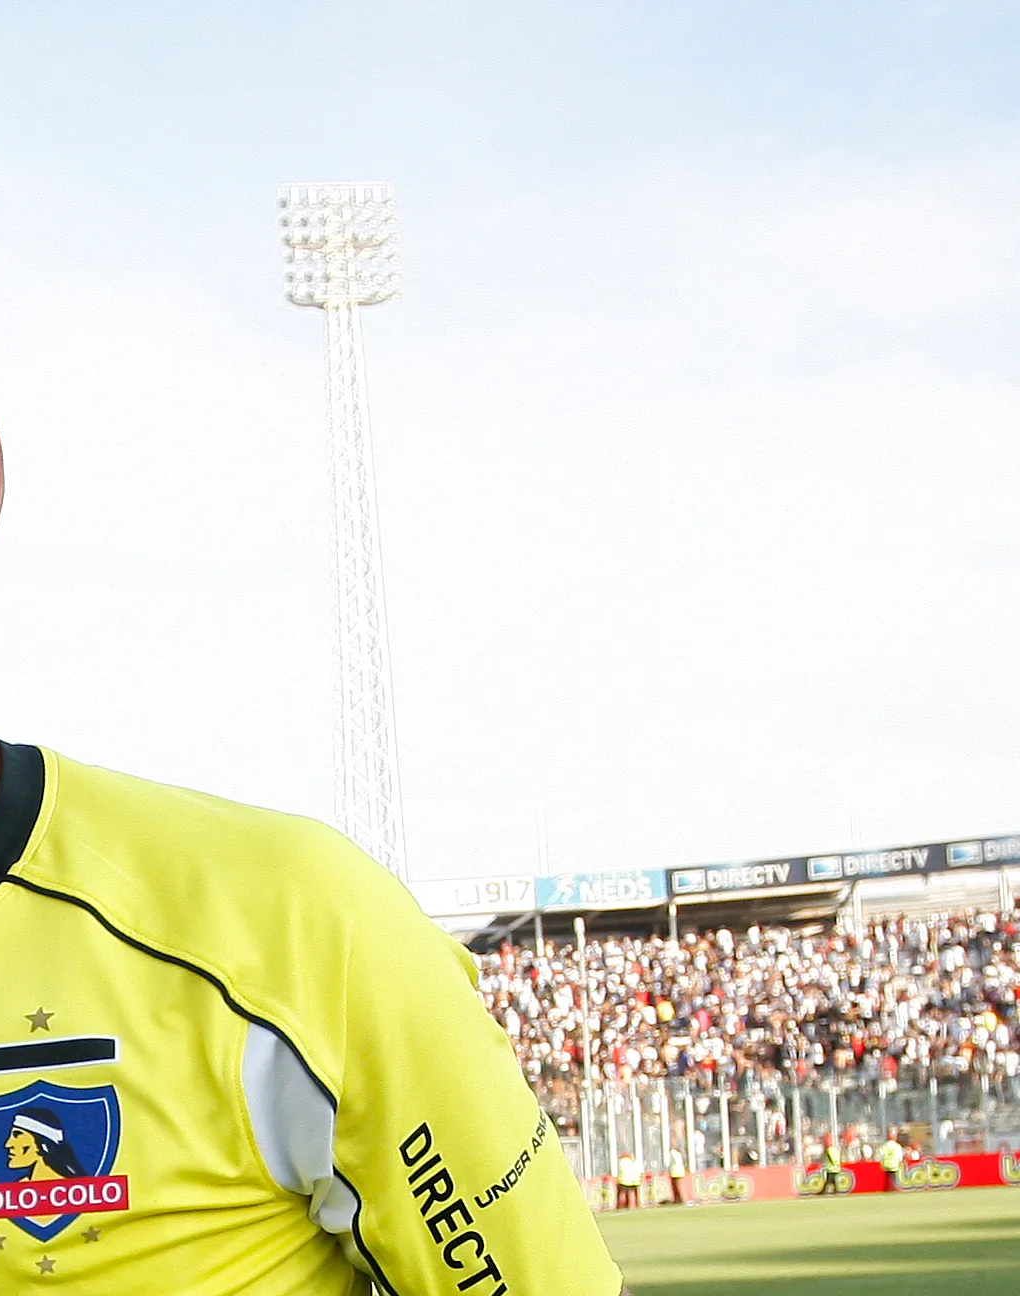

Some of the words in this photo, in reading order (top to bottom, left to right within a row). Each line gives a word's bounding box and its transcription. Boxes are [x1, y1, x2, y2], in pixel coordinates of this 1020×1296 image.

[843, 848, 930, 876] DIRECTV
[579, 876, 653, 902] MEDS
[706, 863, 791, 889] DIRECTV
[474, 1149, 531, 1208] UNDER
